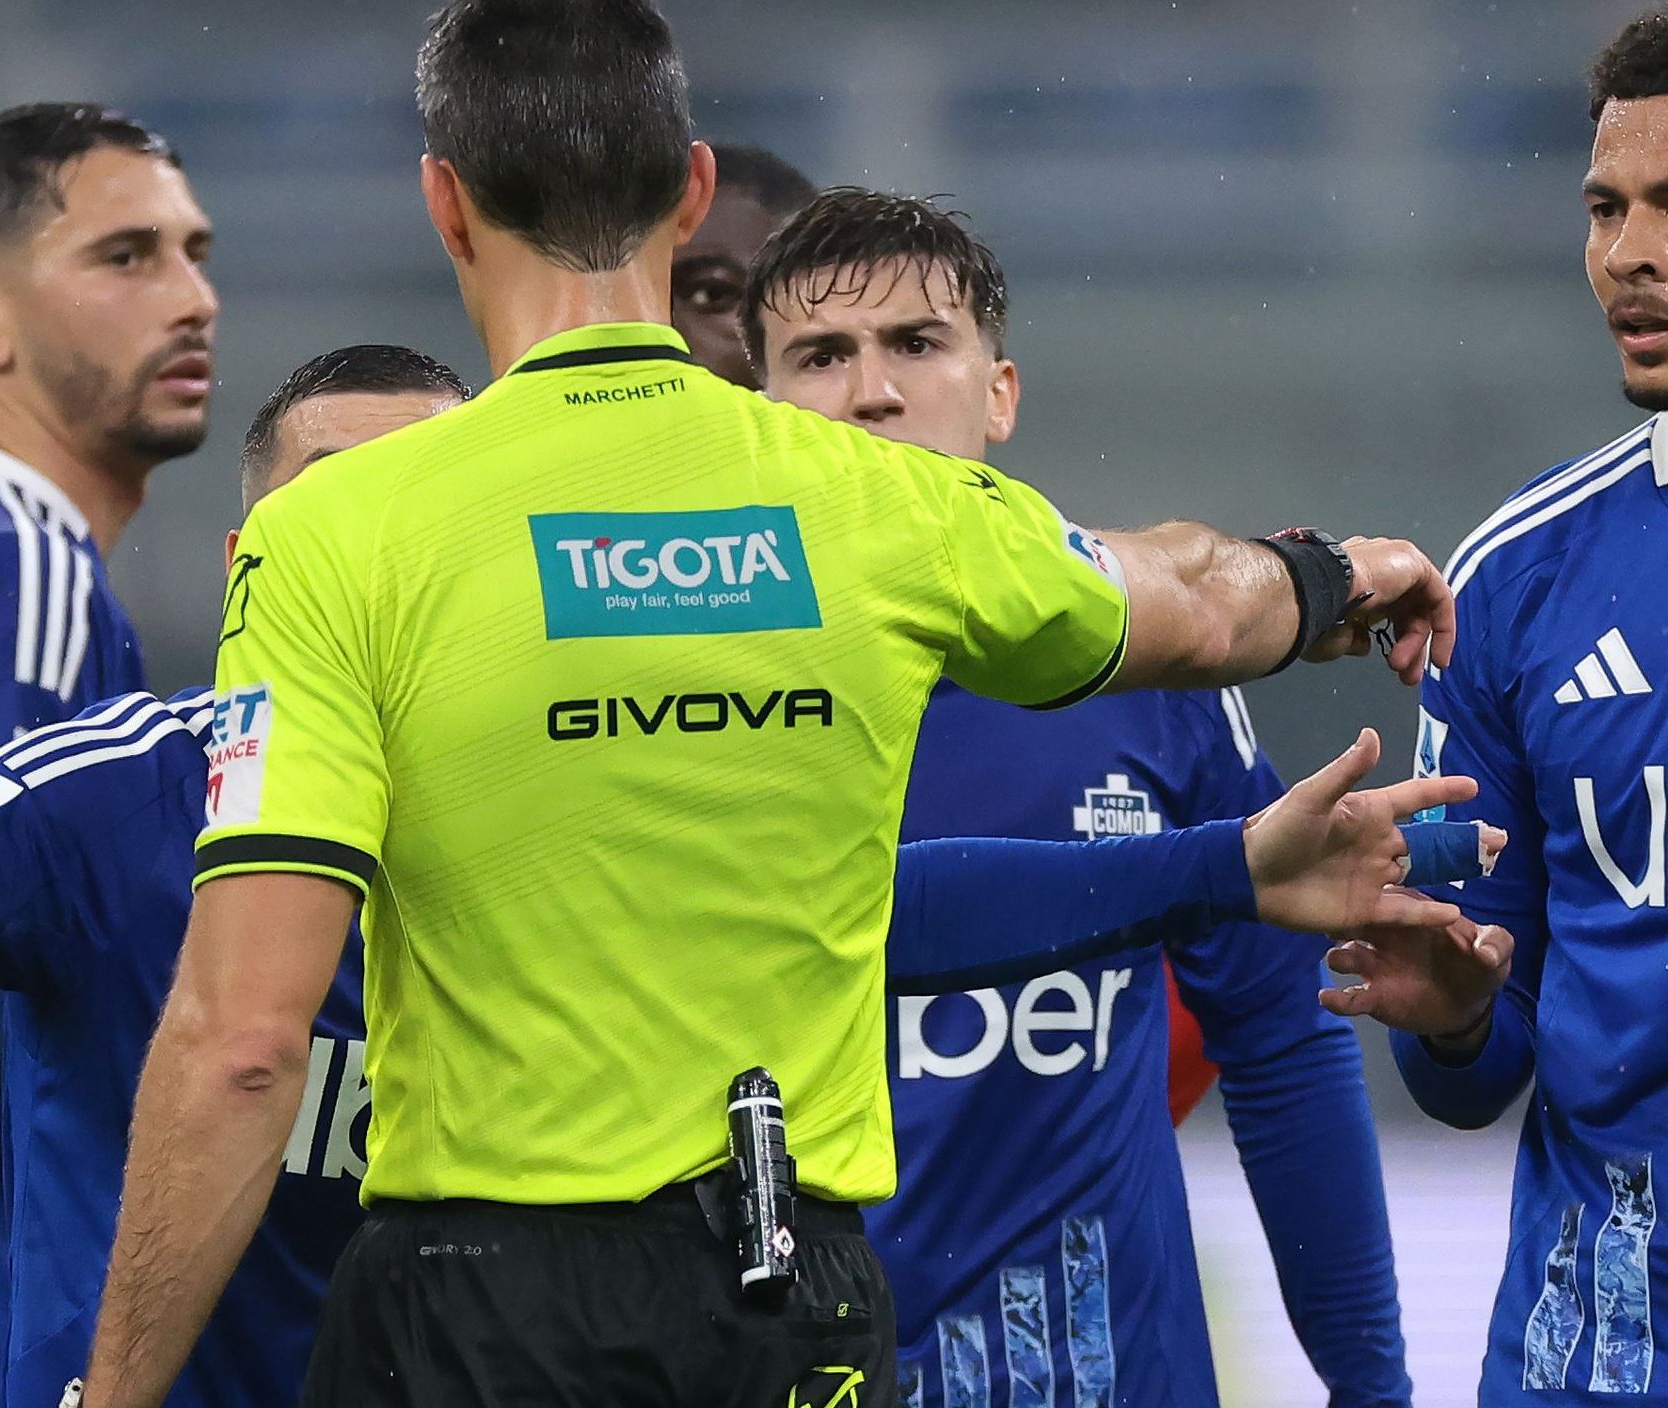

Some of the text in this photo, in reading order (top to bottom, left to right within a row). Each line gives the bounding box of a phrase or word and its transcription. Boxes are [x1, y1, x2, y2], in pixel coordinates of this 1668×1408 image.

[564, 377, 685, 406] MARCHETTI
[605, 589, 751, 610] play fair, feel good
[547, 688, 833, 741] GIVOVA
[1093, 808, 1144, 834] COMO
